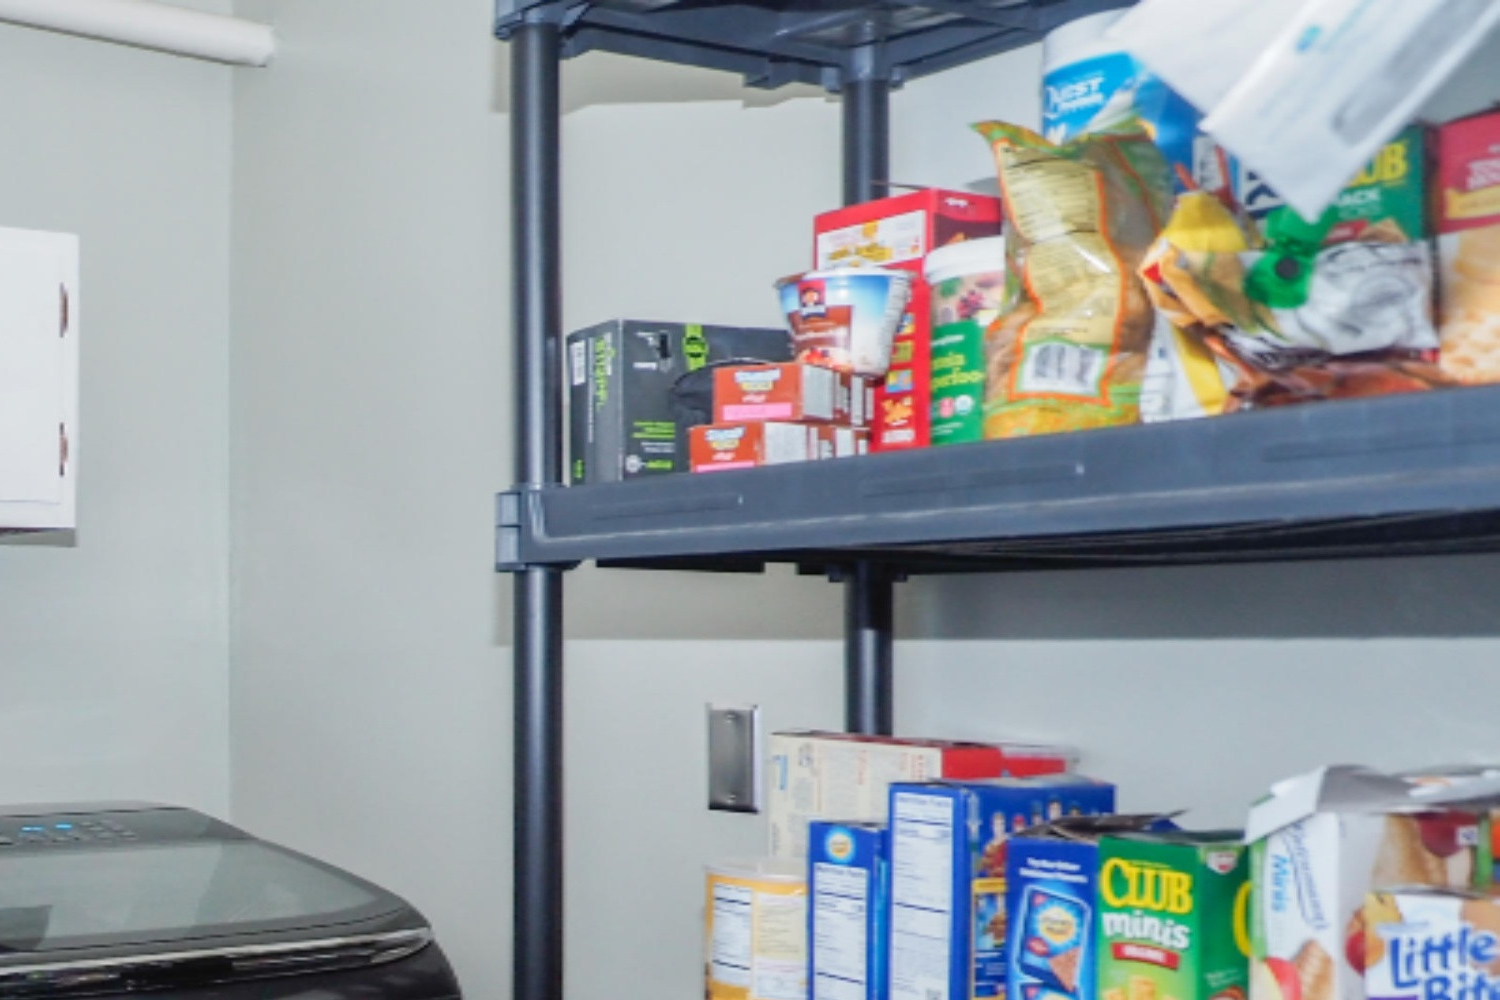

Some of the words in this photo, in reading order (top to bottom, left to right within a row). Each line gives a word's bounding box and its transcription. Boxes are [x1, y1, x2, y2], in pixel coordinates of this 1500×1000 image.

[1101, 857, 1194, 915] CLUB
[1102, 909, 1191, 949] minis
[1389, 926, 1497, 989] Little
